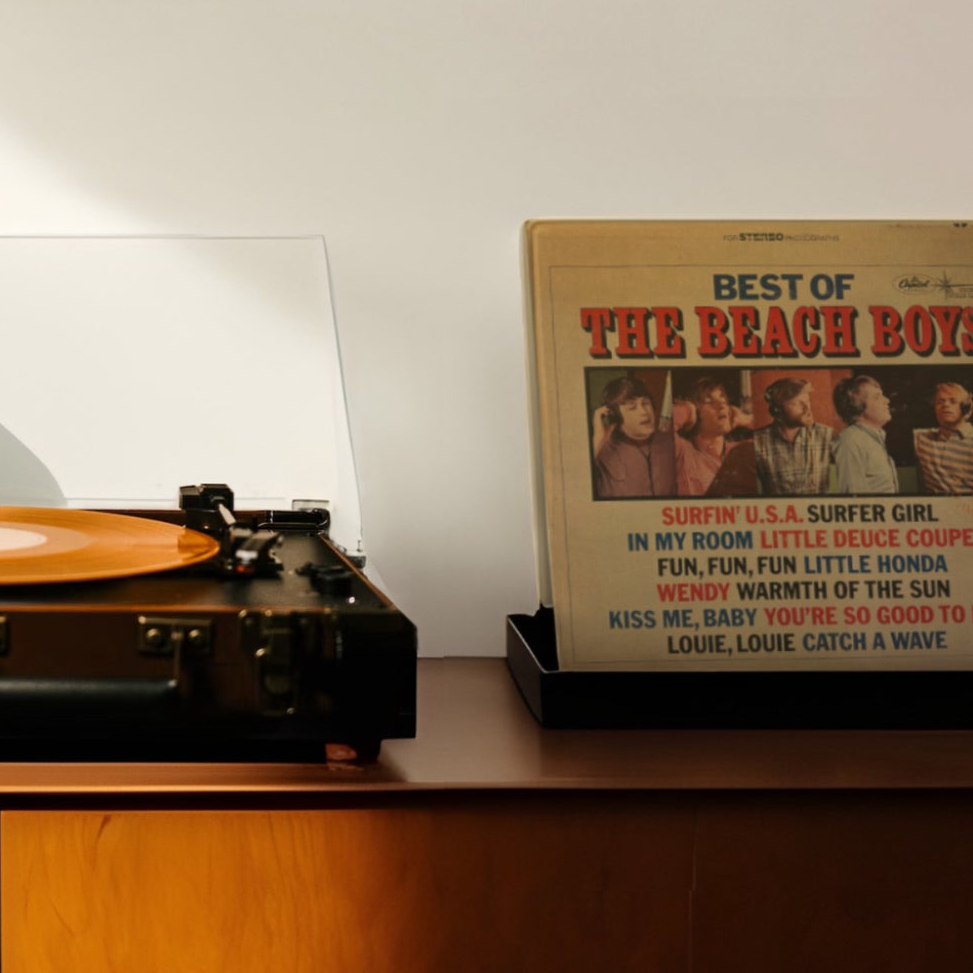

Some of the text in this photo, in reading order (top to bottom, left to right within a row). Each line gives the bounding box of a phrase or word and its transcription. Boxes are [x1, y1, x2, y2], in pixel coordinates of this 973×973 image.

[739, 232, 784, 242] STEREO
[713, 274, 854, 300] BEST OF
[580, 306, 686, 359] THE
[694, 305, 860, 359] BEACH
[662, 504, 939, 526] SURFIN' U.S.A. SURFER GIRL
[628, 528, 973, 551] IN MY ROOM LITTLE DEUCE COUPE
[658, 554, 948, 578] FUN, FUN, FUN LITTLE HONDA
[657, 579, 950, 602] WENDY WARMTH OF THE SUN
[609, 610, 656, 629] KISS
[663, 609, 699, 630] ME,
[704, 608, 757, 627] BABY
[764, 606, 838, 626] YOU'RE
[844, 606, 870, 625] SO
[877, 605, 934, 624] GOOD
[938, 605, 966, 624] TO
[668, 631, 948, 656] LOUIE, LOUIE CATCH A WAVE
